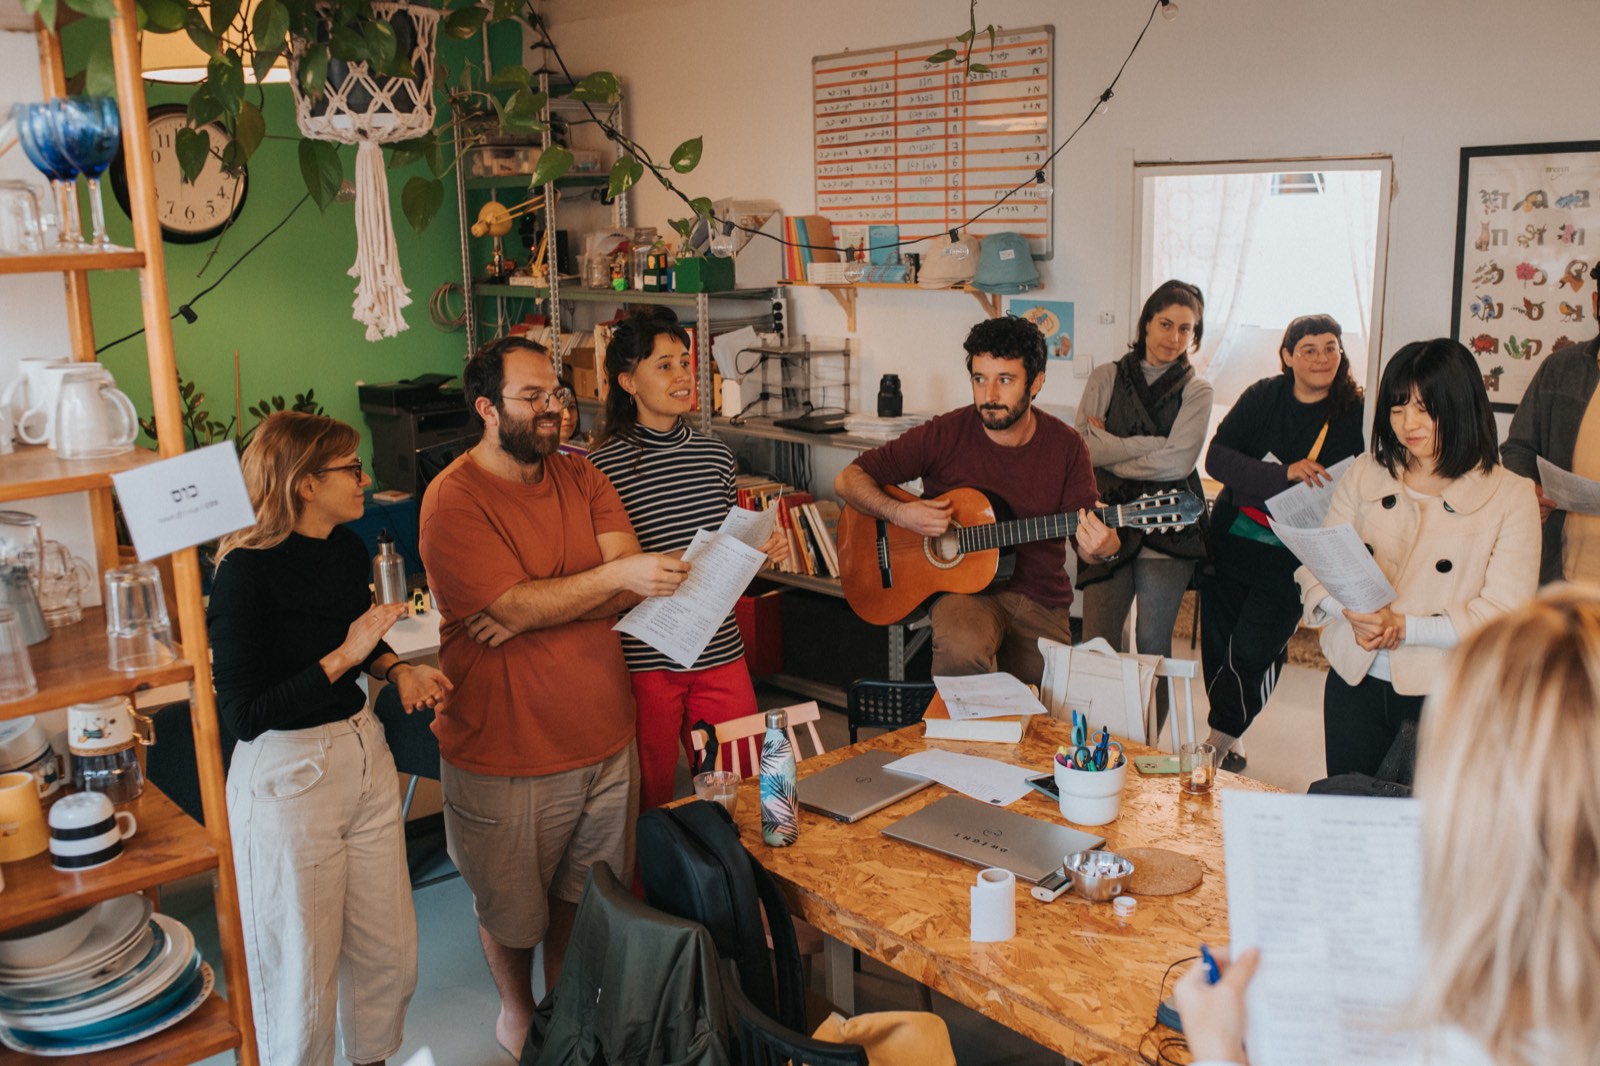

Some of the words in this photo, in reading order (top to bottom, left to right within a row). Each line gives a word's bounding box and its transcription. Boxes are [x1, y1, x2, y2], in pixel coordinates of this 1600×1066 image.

[217, 185, 227, 199] 4
[166, 200, 175, 215] 7
[184, 205, 195, 220] 6
[205, 200, 215, 215] 5
[953, 832, 1008, 853] DWIGHT
